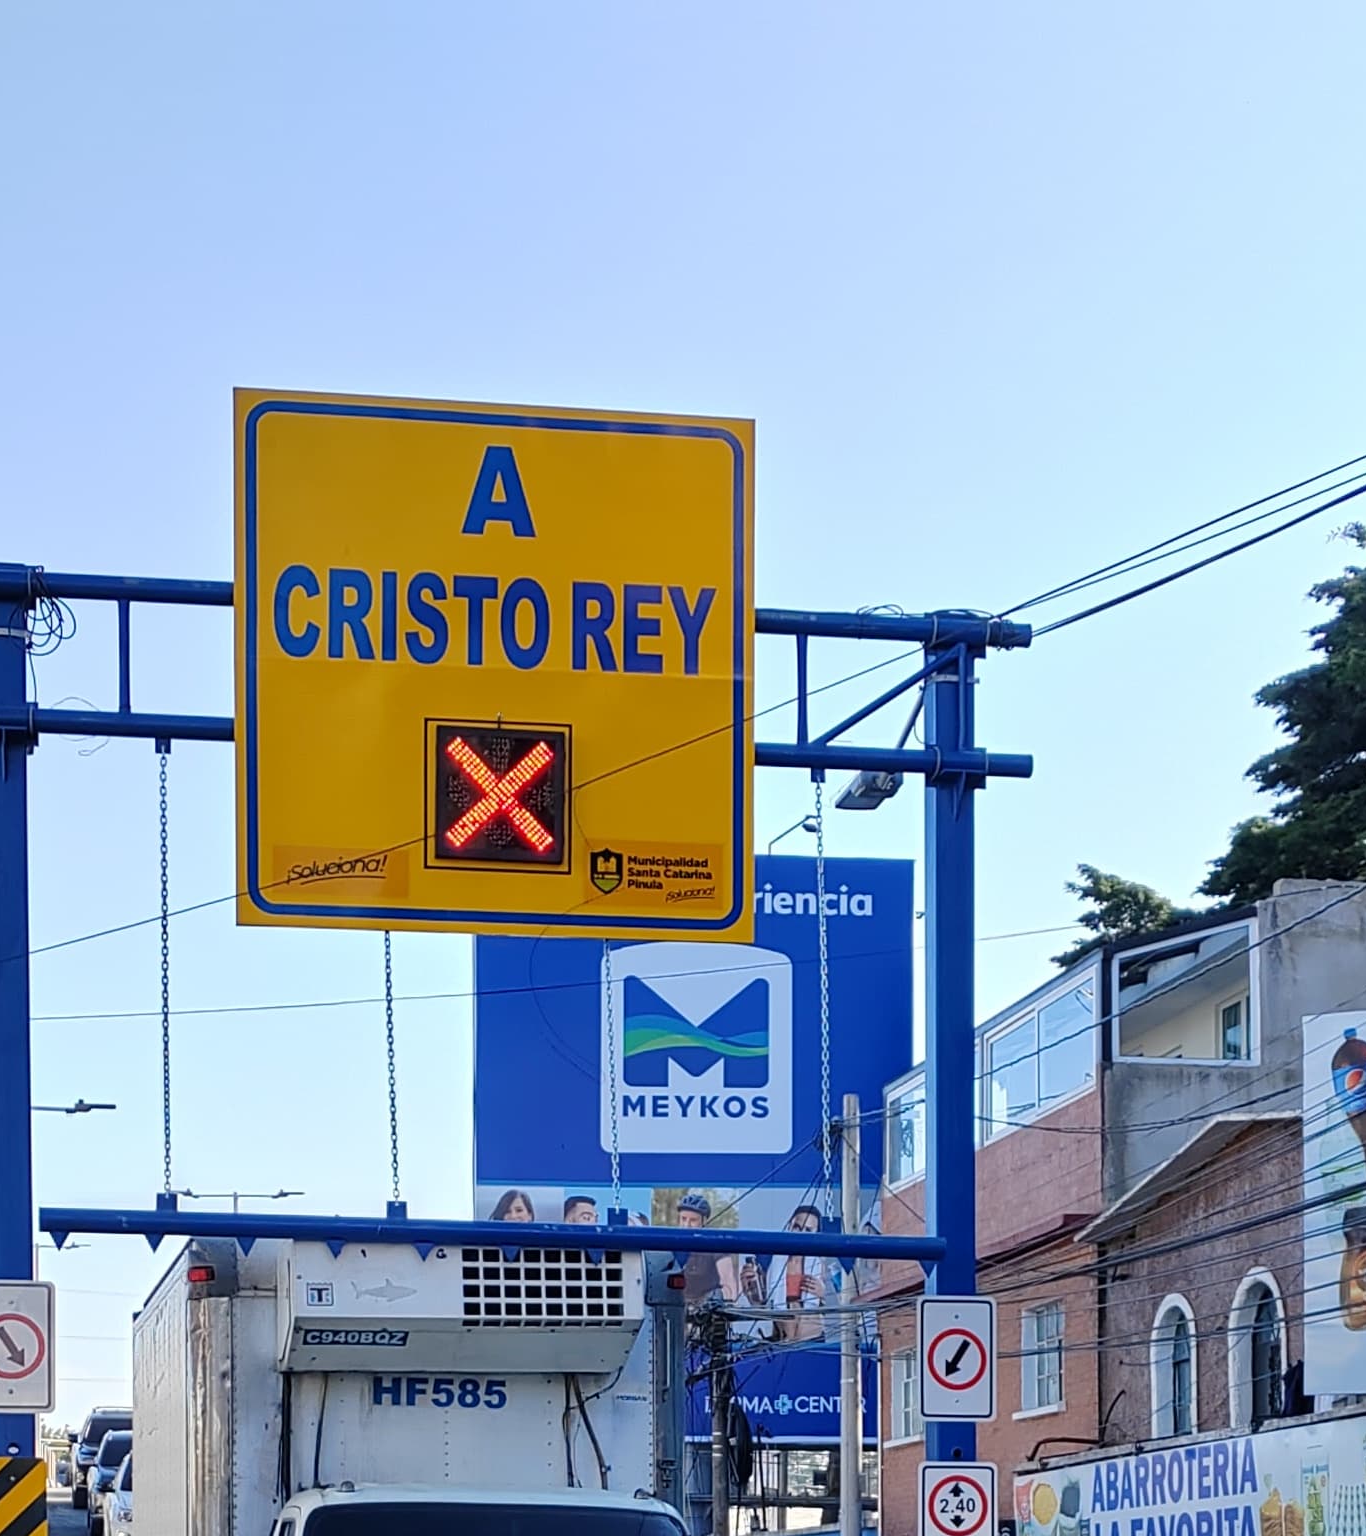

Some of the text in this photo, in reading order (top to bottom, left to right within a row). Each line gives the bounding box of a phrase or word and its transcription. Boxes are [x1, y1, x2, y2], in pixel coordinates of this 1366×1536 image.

[460, 445, 537, 538] A
[273, 563, 717, 676] CRISTO REY
[627, 855, 709, 868] Municipalidad
[627, 867, 713, 880] Santa Catarina
[627, 878, 664, 890] Pinula
[621, 1095, 770, 1119] MEYKOS
[305, 1330, 406, 1345] C940BQZ
[372, 1375, 508, 1410] HF585
[794, 1395, 867, 1414] CENT
[1091, 1438, 1259, 1514] ABARROTERIA
[939, 1497, 976, 1514] 2.40
